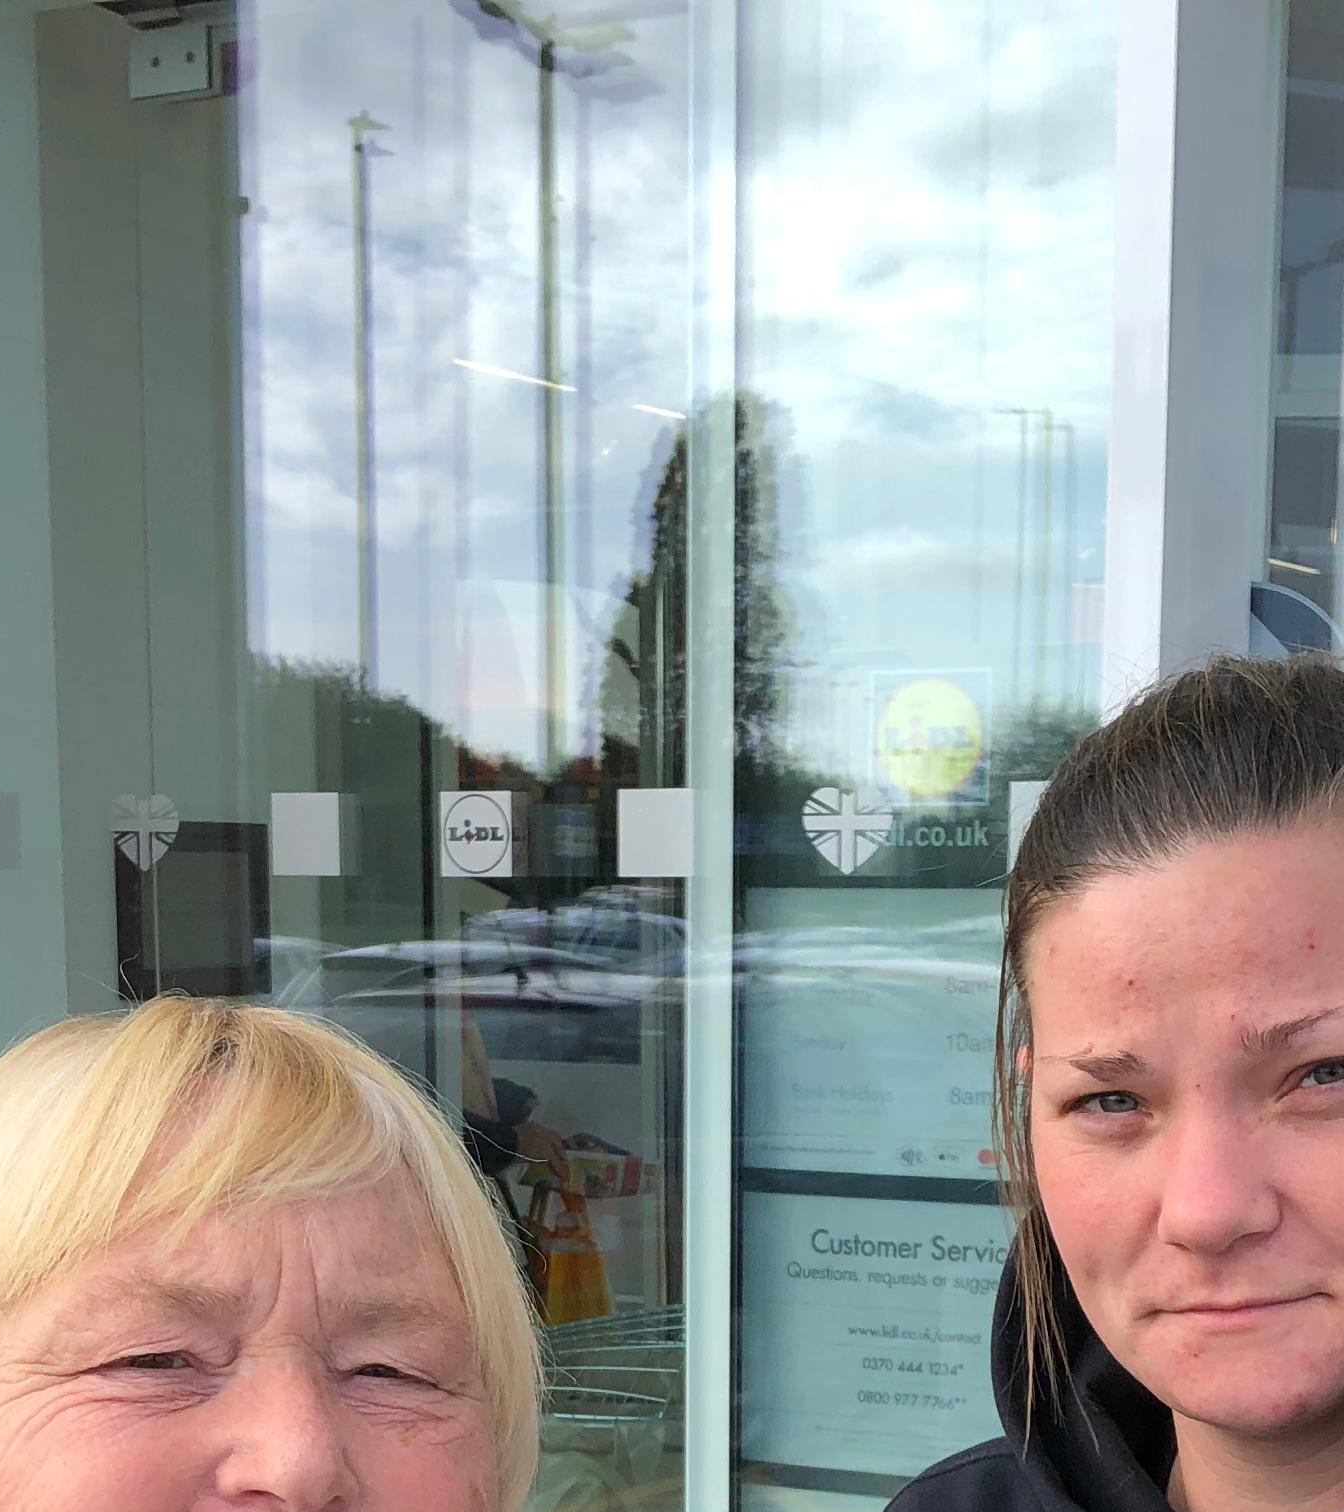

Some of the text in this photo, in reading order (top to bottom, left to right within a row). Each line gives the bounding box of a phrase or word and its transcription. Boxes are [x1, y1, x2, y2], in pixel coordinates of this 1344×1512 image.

[811, 1227, 923, 1260] Customer
[867, 1270, 929, 1288] requests
[932, 1276, 947, 1287] or
[862, 1356, 894, 1371] 0370
[898, 1361, 923, 1374] 444
[857, 1389, 891, 1405] 0800
[894, 1392, 919, 1406] 977
